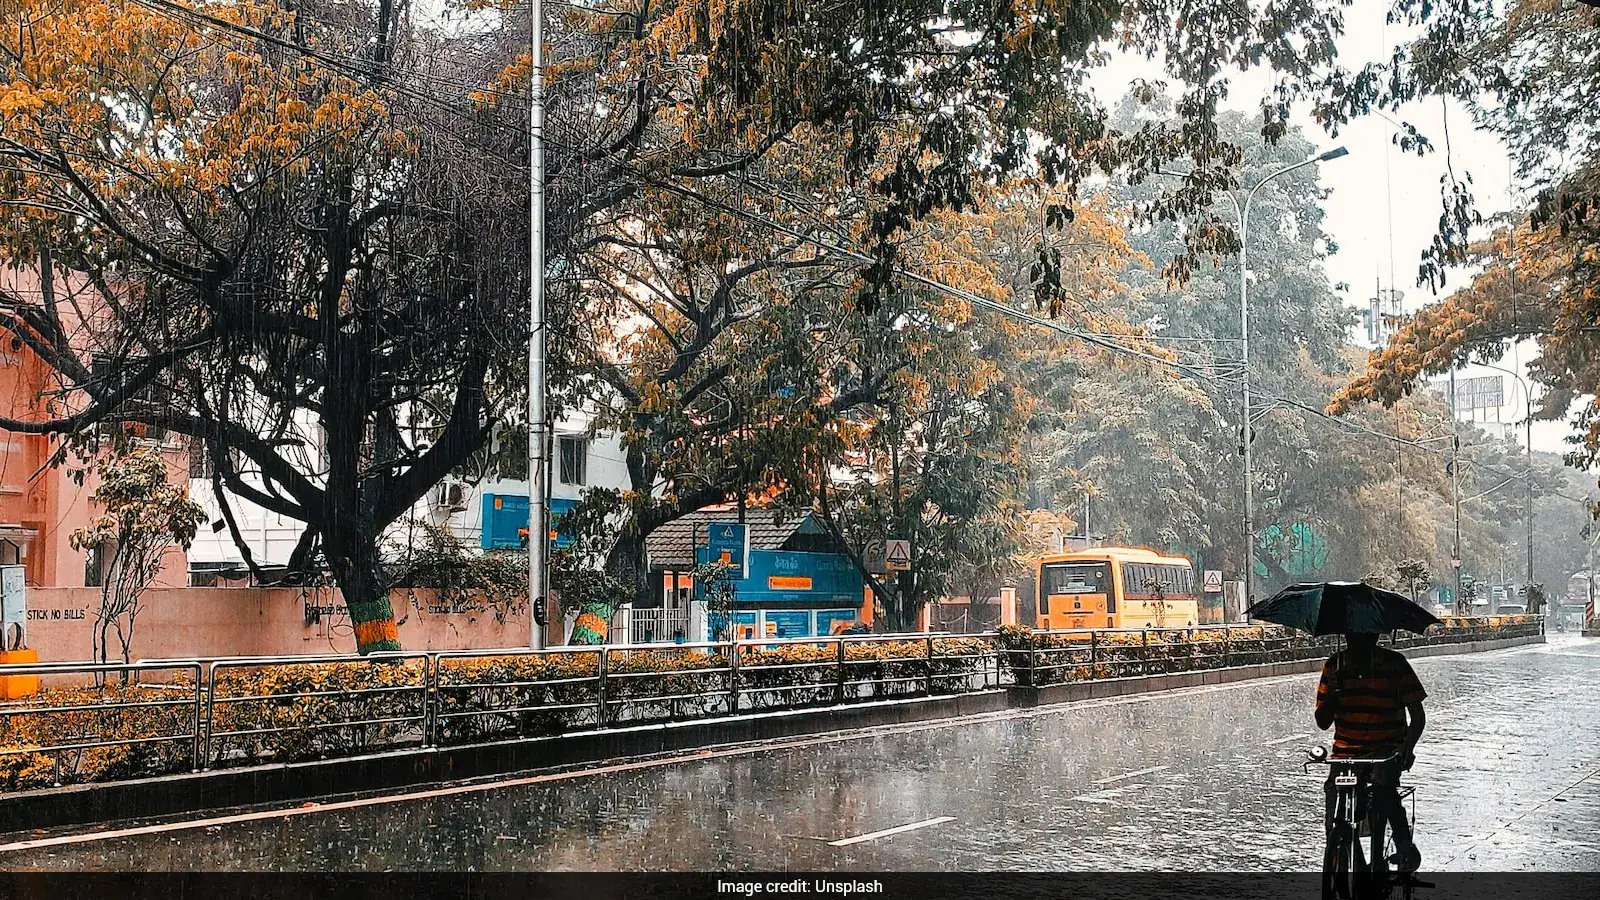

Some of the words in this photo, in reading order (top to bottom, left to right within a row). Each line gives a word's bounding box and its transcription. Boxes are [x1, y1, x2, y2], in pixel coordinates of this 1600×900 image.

[27, 609, 48, 620] STICK
[51, 609, 61, 620] NO
[64, 609, 85, 620] BILLS
